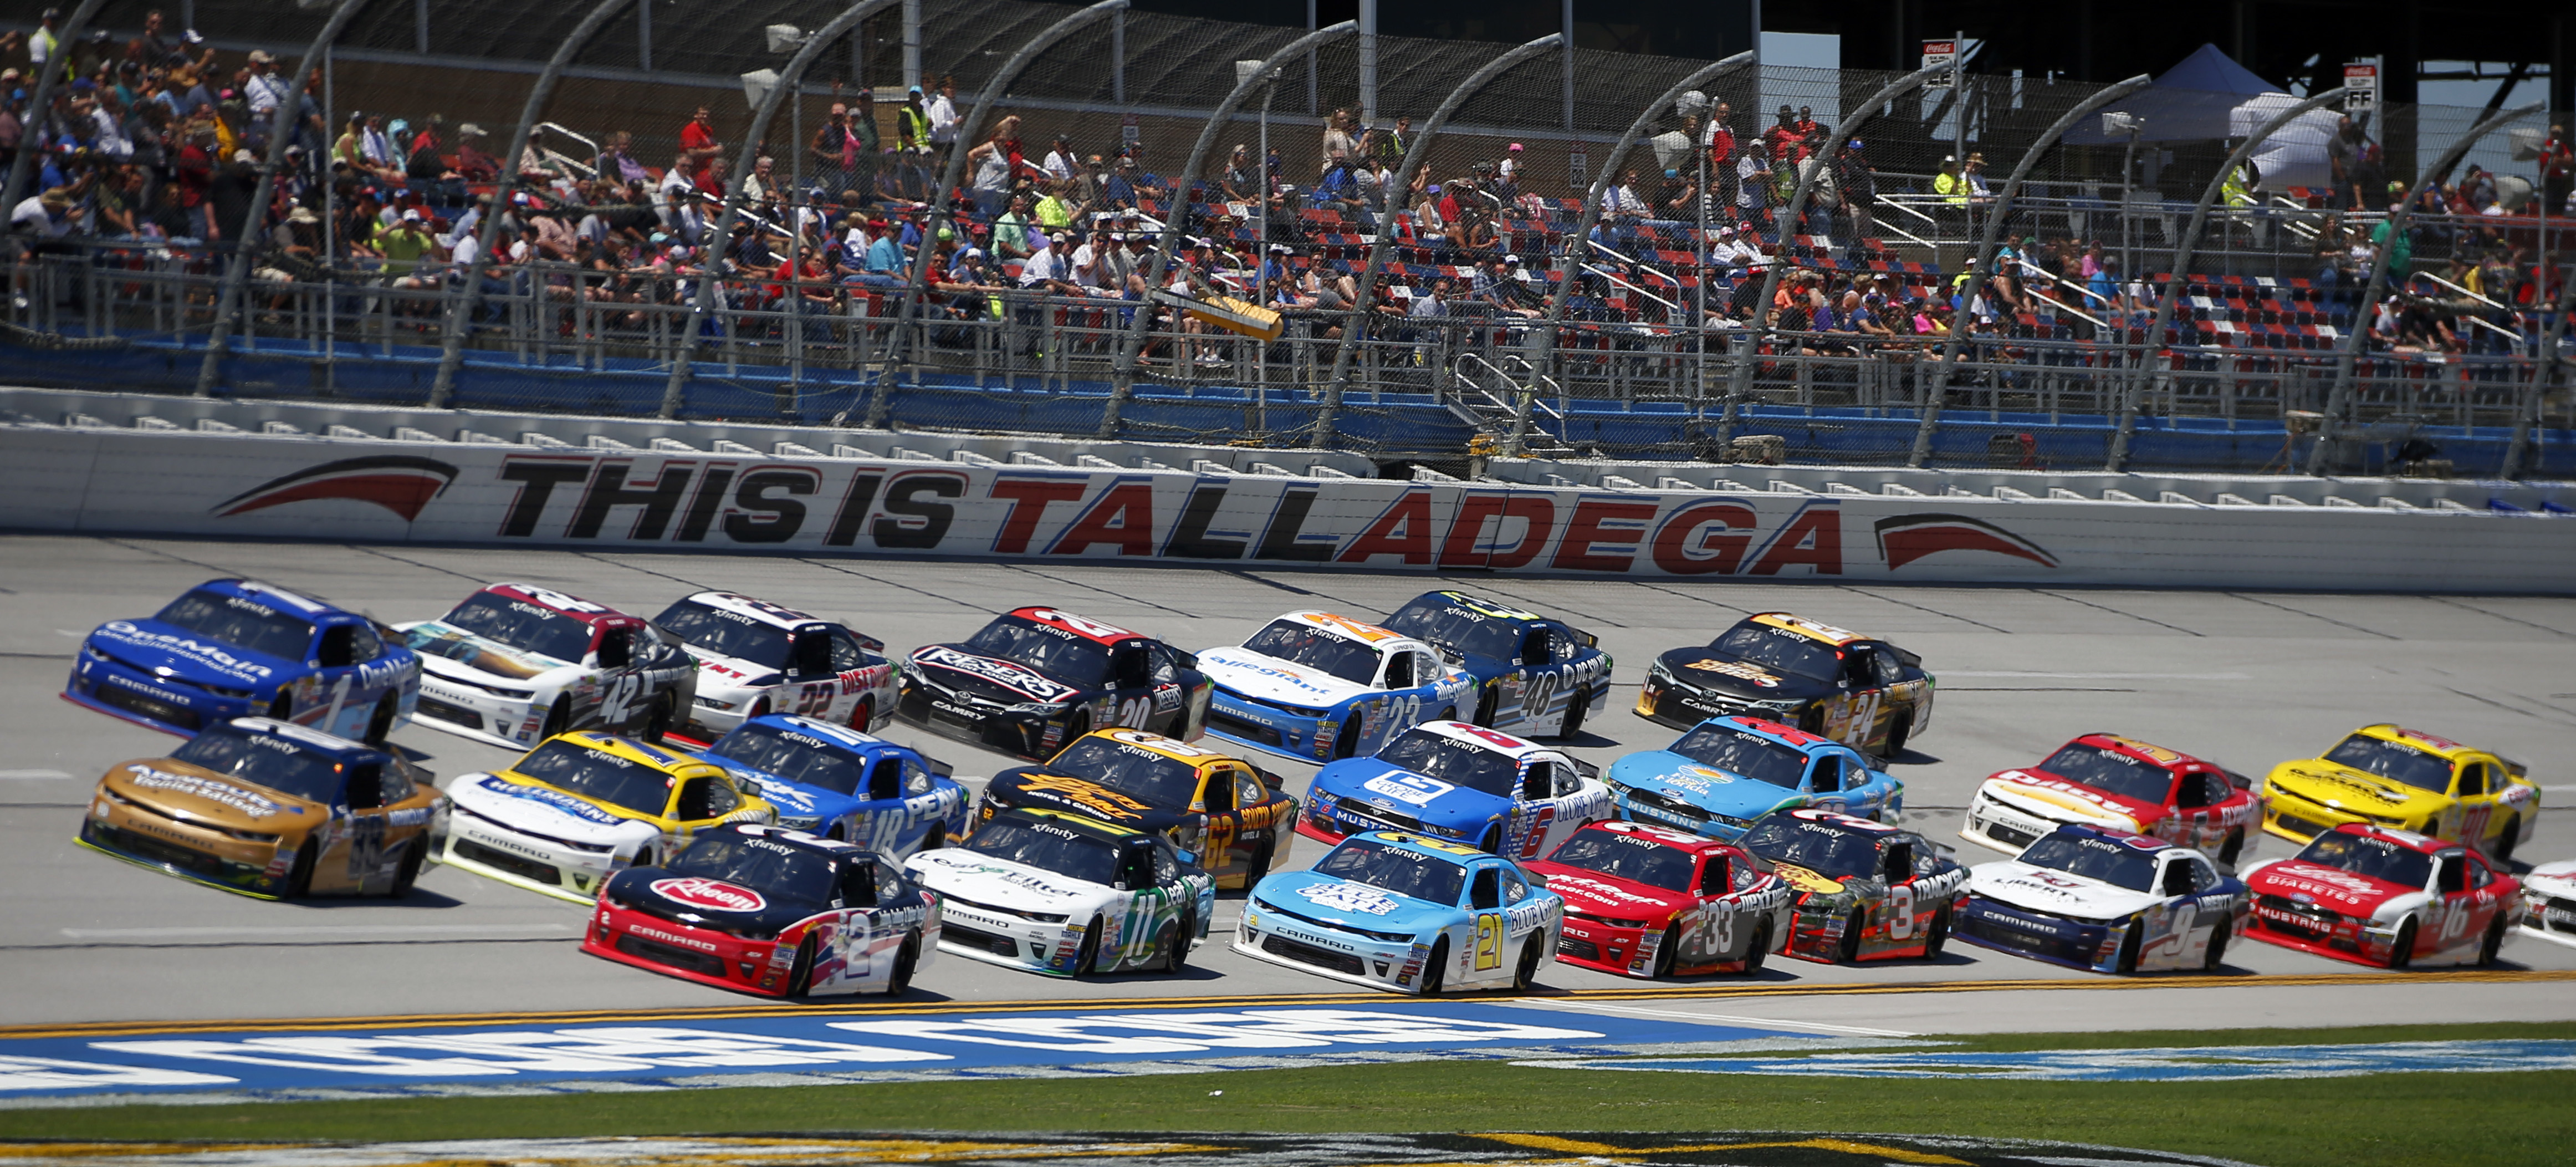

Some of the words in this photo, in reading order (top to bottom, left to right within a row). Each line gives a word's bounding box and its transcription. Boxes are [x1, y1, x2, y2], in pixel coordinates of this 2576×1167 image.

[1926, 44, 1951, 53] Coca-Cola
[2349, 90, 2372, 106] FF
[498, 453, 821, 543] THIS
[824, 465, 969, 550] IS
[988, 474, 1843, 577] TALLADEGA
[509, 602, 555, 620] xfinity
[712, 609, 757, 626] xfinity
[1443, 607, 1485, 623] xfinity
[1034, 623, 1078, 640] xfinity
[1305, 626, 1348, 644] xfinity
[1769, 627, 1811, 643] xfinity
[106, 621, 272, 677] OneMain
[1210, 656, 1331, 695] allegiant
[1575, 662, 1588, 684] DC
[108, 674, 190, 705] CAMARO
[420, 684, 474, 704] MARO
[600, 674, 640, 724] 42
[795, 682, 836, 719] 22
[1434, 677, 1470, 704] allegiant
[1520, 671, 1558, 722] 48
[322, 673, 352, 732] 1
[932, 700, 987, 720] CAMRY
[1120, 695, 1152, 731] 20
[1212, 703, 1272, 726] AMARO
[1681, 697, 1730, 716] CAMRY
[1385, 694, 1421, 741] 23
[1847, 690, 1882, 745] 24
[249, 735, 301, 754] xfinity
[779, 730, 827, 749] xfinity
[1440, 736, 1484, 755] xfinity
[1734, 731, 1770, 747] xfinity
[584, 748, 633, 769] xfinity
[1117, 743, 1165, 762] xfinity
[1377, 781, 1429, 799] GLOBE
[1378, 786, 1410, 799] LIFE
[904, 786, 960, 829] PEAK
[983, 807, 993, 820] 62
[1027, 790, 1060, 802] HOTEL
[1072, 802, 1112, 821] CASINO
[1320, 804, 1332, 813] 6
[1556, 798, 1589, 823] GLOBE
[1627, 800, 1700, 829] MUSTANG
[1240, 806, 1270, 830] SOUTH
[1799, 823, 1845, 837] xfinity
[871, 807, 905, 854] 18
[1030, 823, 1080, 840] xfinity
[1203, 813, 1235, 870] 62
[1240, 830, 1254, 840] HOTEL
[1520, 807, 1556, 858] 6
[1613, 834, 1660, 850] xfinity
[469, 829, 551, 860] CAMARO
[744, 838, 796, 856] xfinity
[1381, 845, 1429, 862] xfinity
[2078, 838, 2122, 854] xfinity
[663, 878, 756, 911] Rheem
[2266, 875, 2360, 905] DIABETES
[601, 911, 611, 925] 2
[942, 907, 1009, 928] AMARO
[1249, 914, 1258, 927] 21
[1508, 906, 1538, 932] BLUE
[1890, 885, 1914, 940] 3
[1983, 910, 2058, 935] CAMARO
[2258, 906, 2332, 932] MUSTANG
[2440, 897, 2471, 941] 16
[1125, 894, 1157, 957] 11
[1705, 899, 1734, 955] 33
[2163, 903, 2197, 956] 9
[629, 924, 716, 952] CAMARO
[845, 912, 871, 977] 2
[1276, 926, 1354, 951] CAMARO
[1474, 913, 1504, 972] 21
